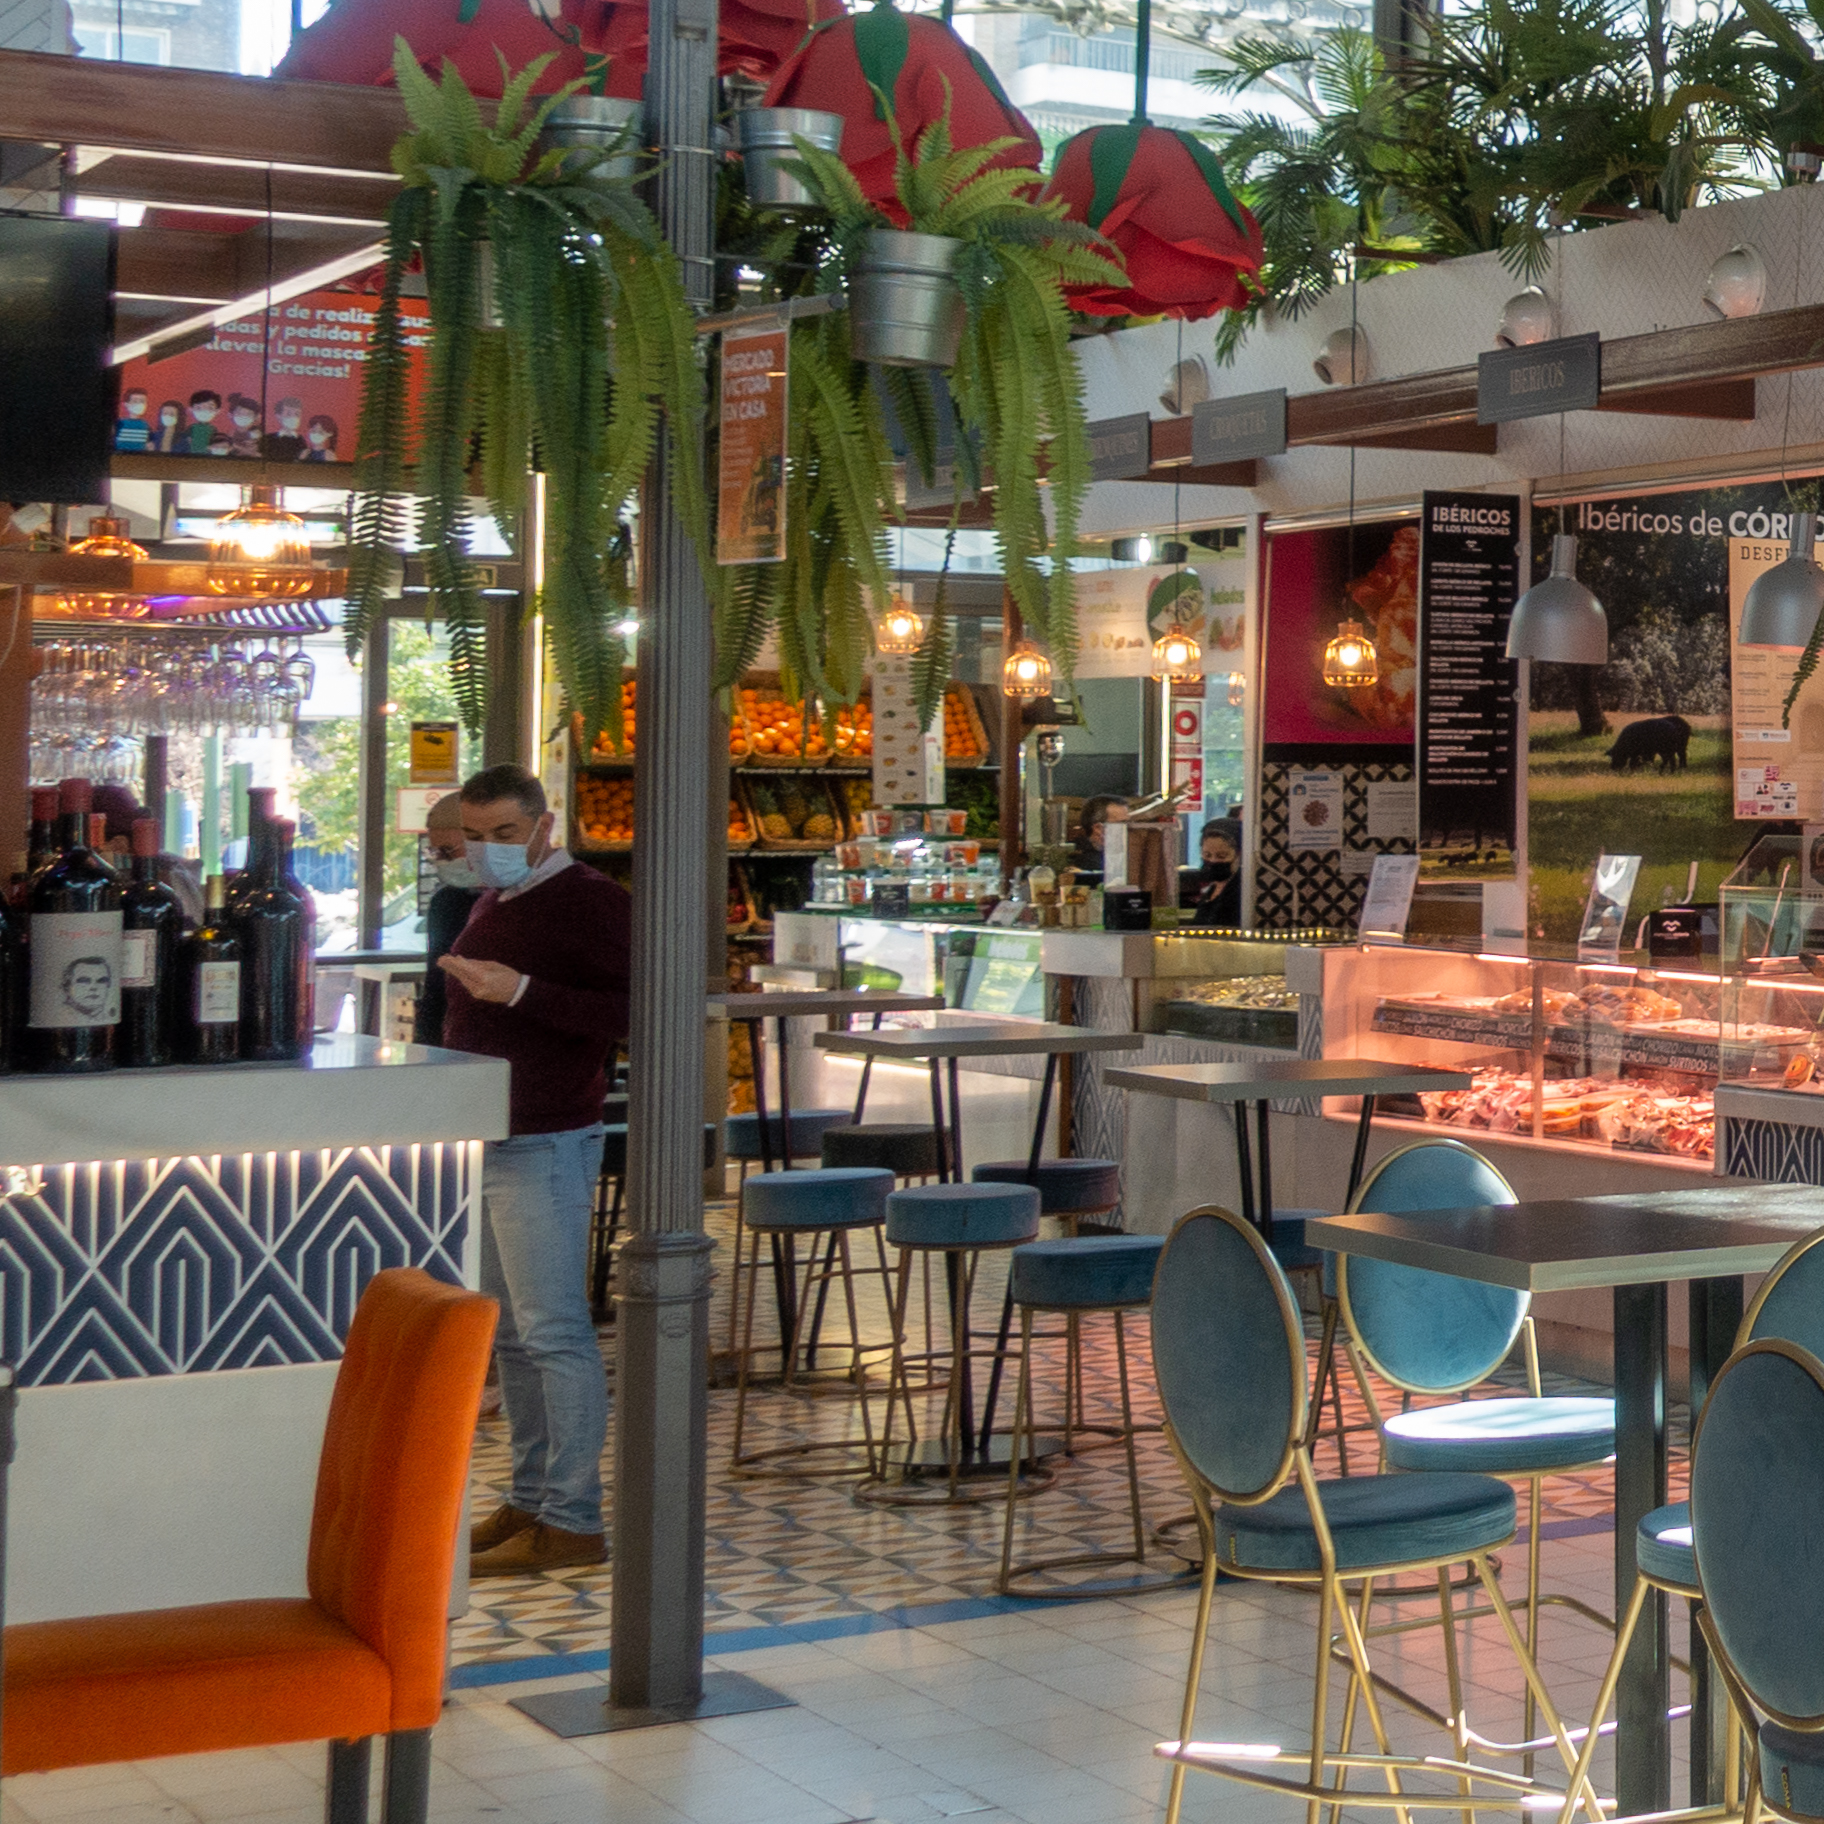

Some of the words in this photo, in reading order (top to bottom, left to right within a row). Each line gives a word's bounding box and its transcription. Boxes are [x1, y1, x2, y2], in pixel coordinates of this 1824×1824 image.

[284, 325, 362, 343] pedidos
[277, 340, 297, 356] la
[268, 359, 350, 379] Gracias!
[1432, 504, 1511, 526] IBÉRICOS
[1578, 503, 1683, 535] Ibéricos
[1690, 511, 1723, 536] de
[1432, 524, 1445, 533] DE
[1445, 525, 1461, 534] LOS
[1462, 525, 1511, 536] PEDROCHES
